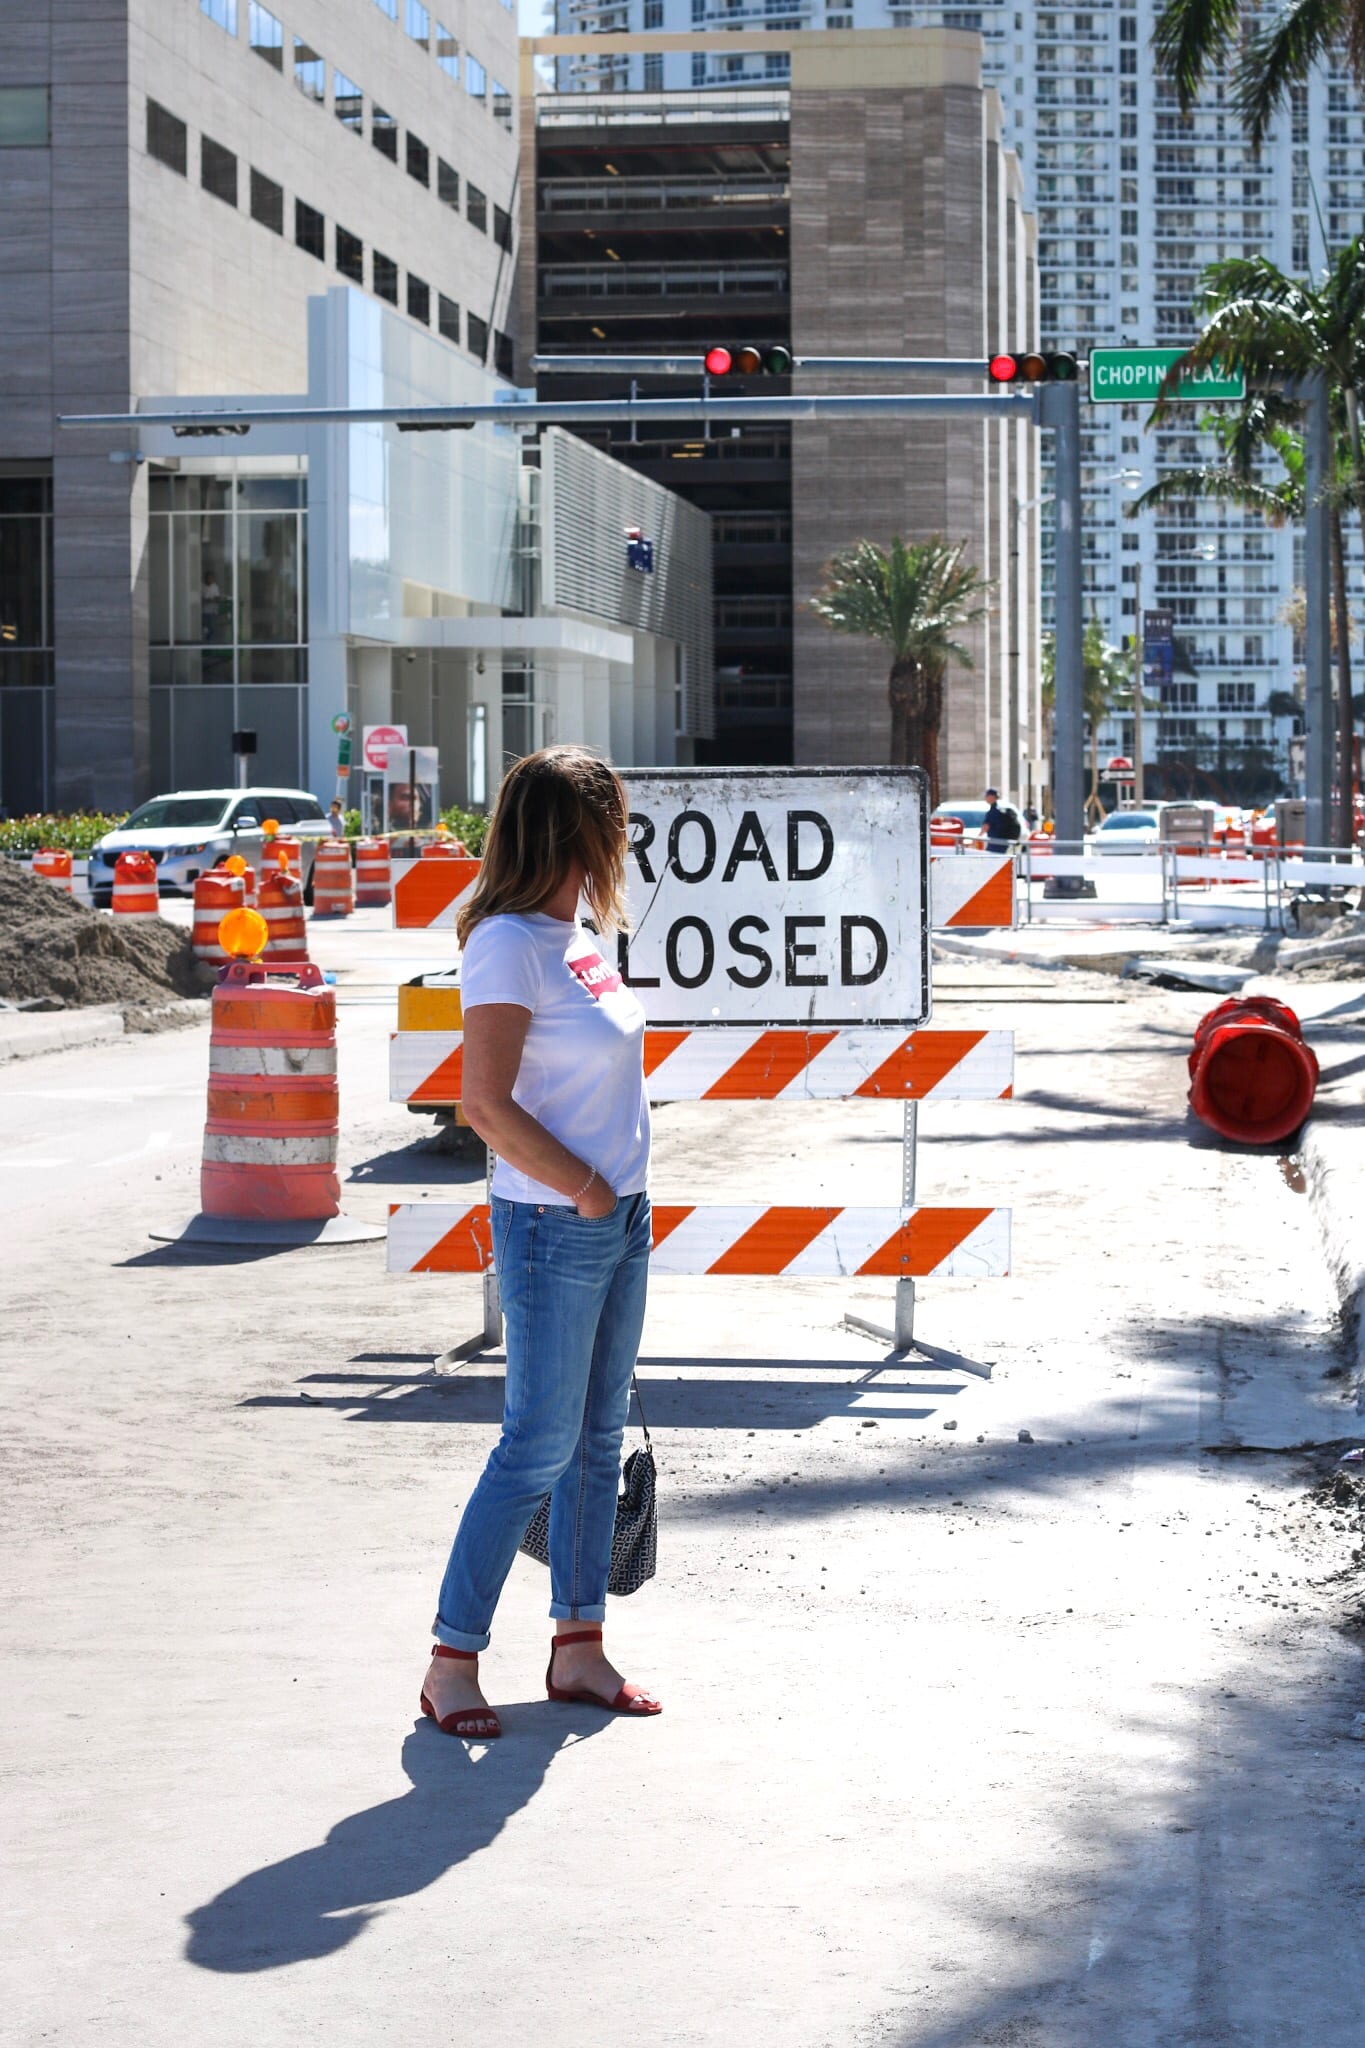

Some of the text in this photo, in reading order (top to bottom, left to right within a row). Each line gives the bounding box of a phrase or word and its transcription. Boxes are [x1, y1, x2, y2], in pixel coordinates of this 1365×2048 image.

[1097, 365, 1168, 385] CHOPIN
[627, 809, 834, 884] ROAD
[581, 914, 888, 989] LOSED
